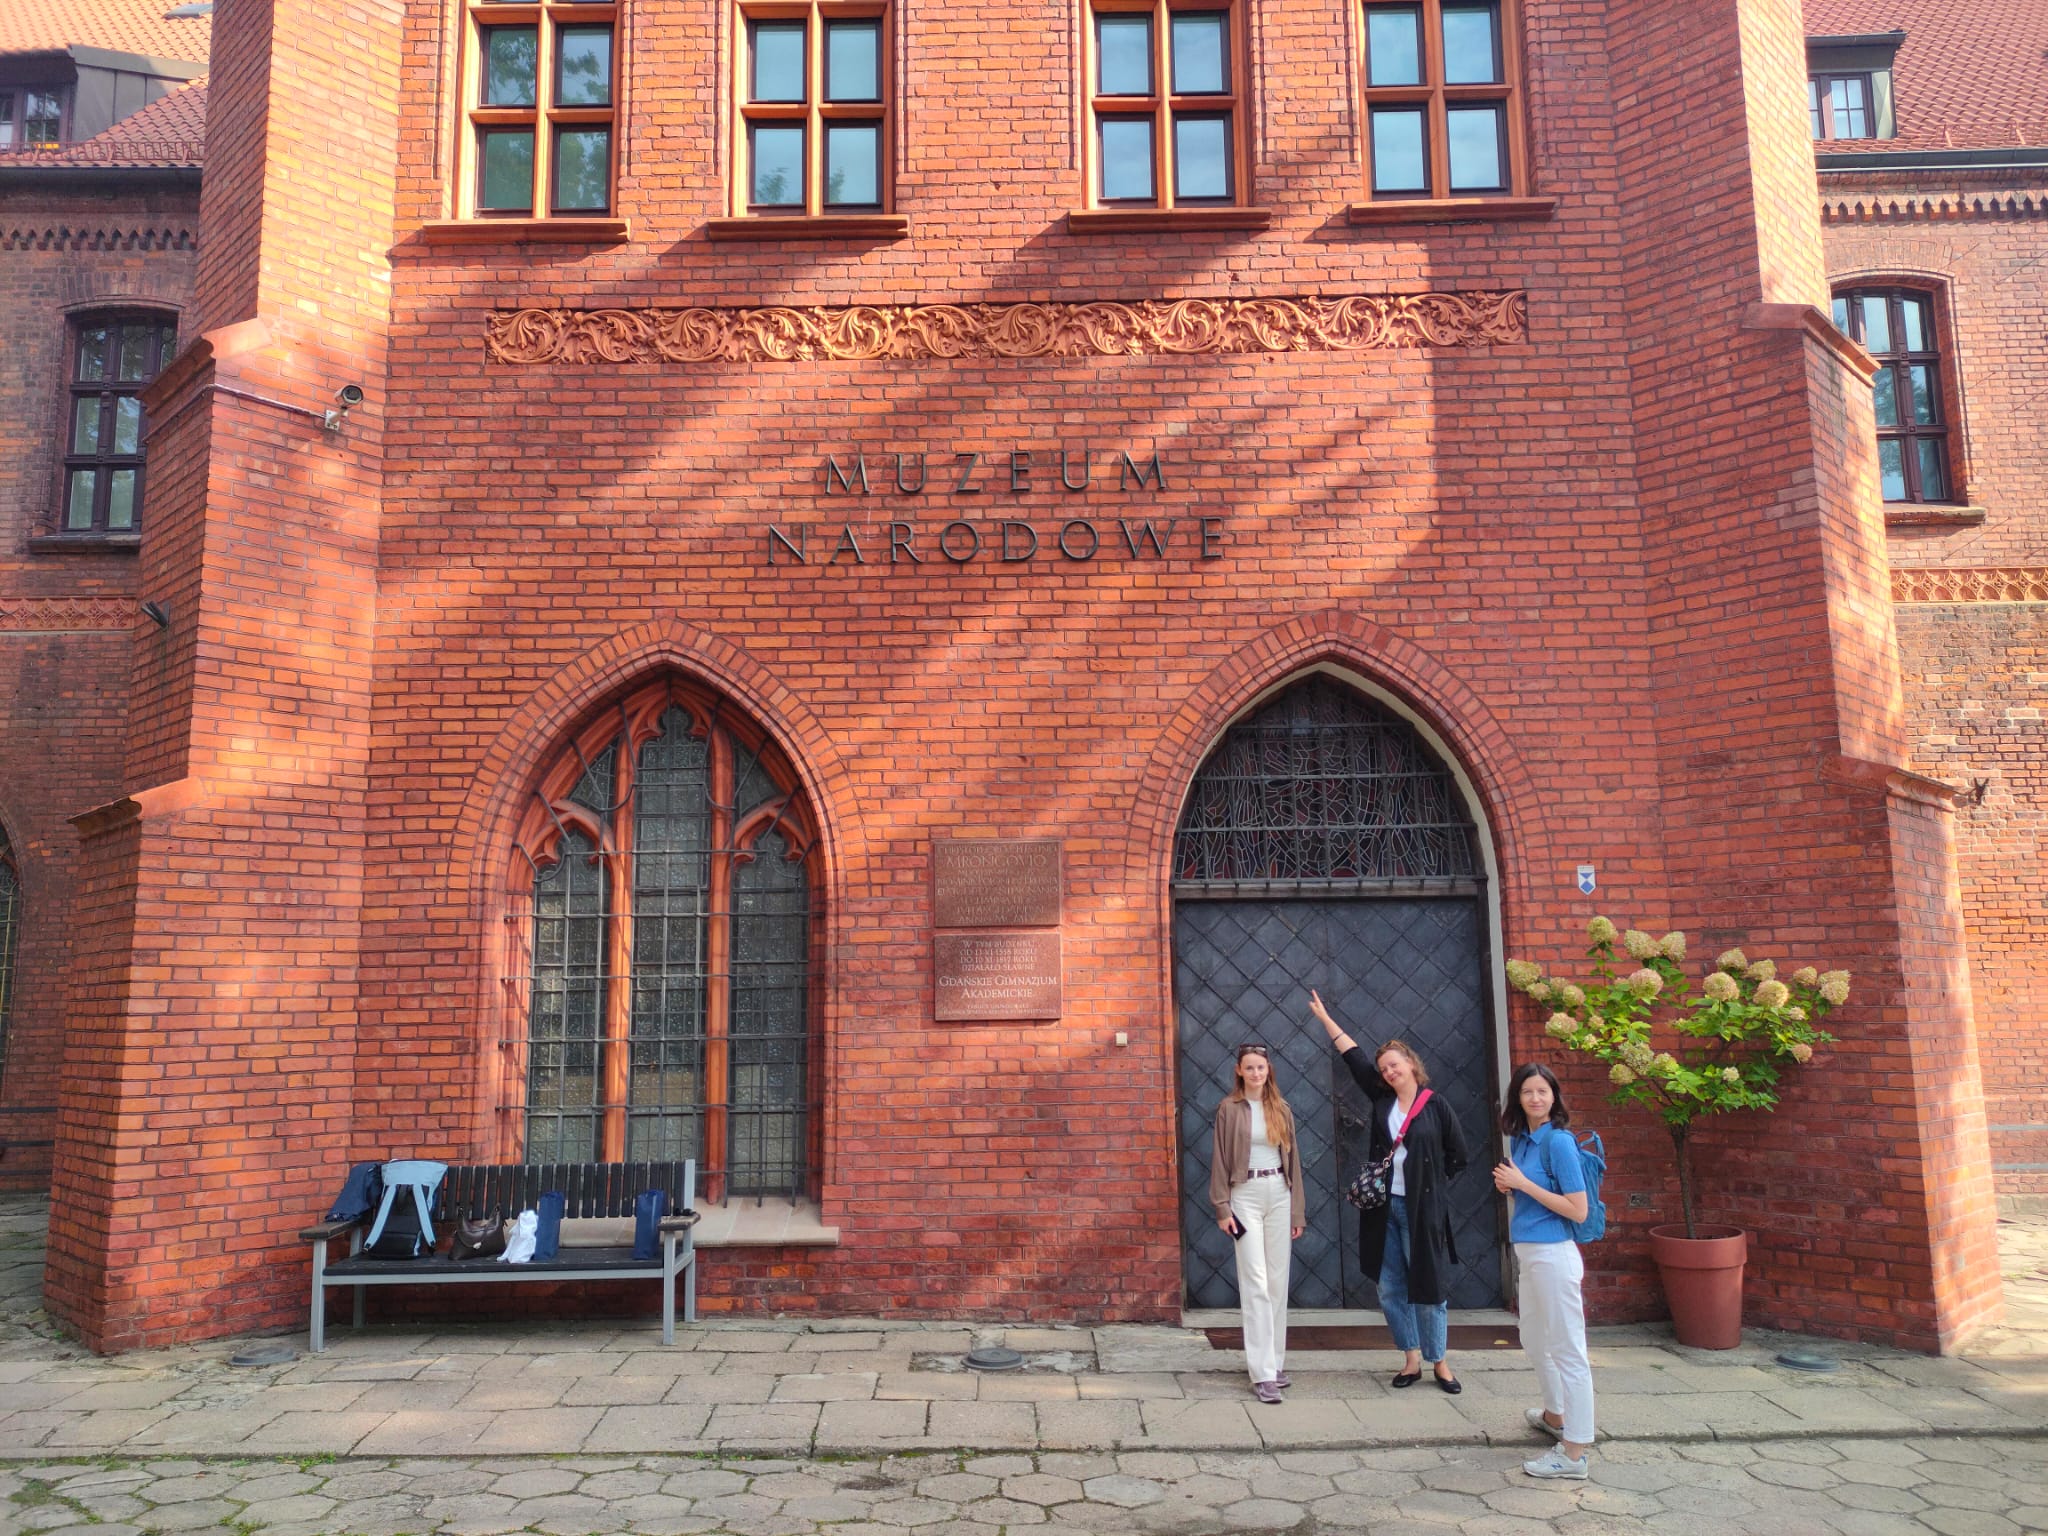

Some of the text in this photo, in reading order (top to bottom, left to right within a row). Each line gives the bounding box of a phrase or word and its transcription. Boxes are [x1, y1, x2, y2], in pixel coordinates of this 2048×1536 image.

[825, 450, 1166, 495] MUZEUM
[767, 516, 1224, 565] NARODOWE
[975, 940, 993, 948] TYM
[960, 948, 974, 956] OD
[1013, 947, 1037, 956] ROKU
[960, 956, 974, 964] DO
[1013, 955, 1037, 963] ROKU
[994, 974, 1058, 987] GIMNAZJUM
[960, 988, 1034, 999] AKADEMICKIE
